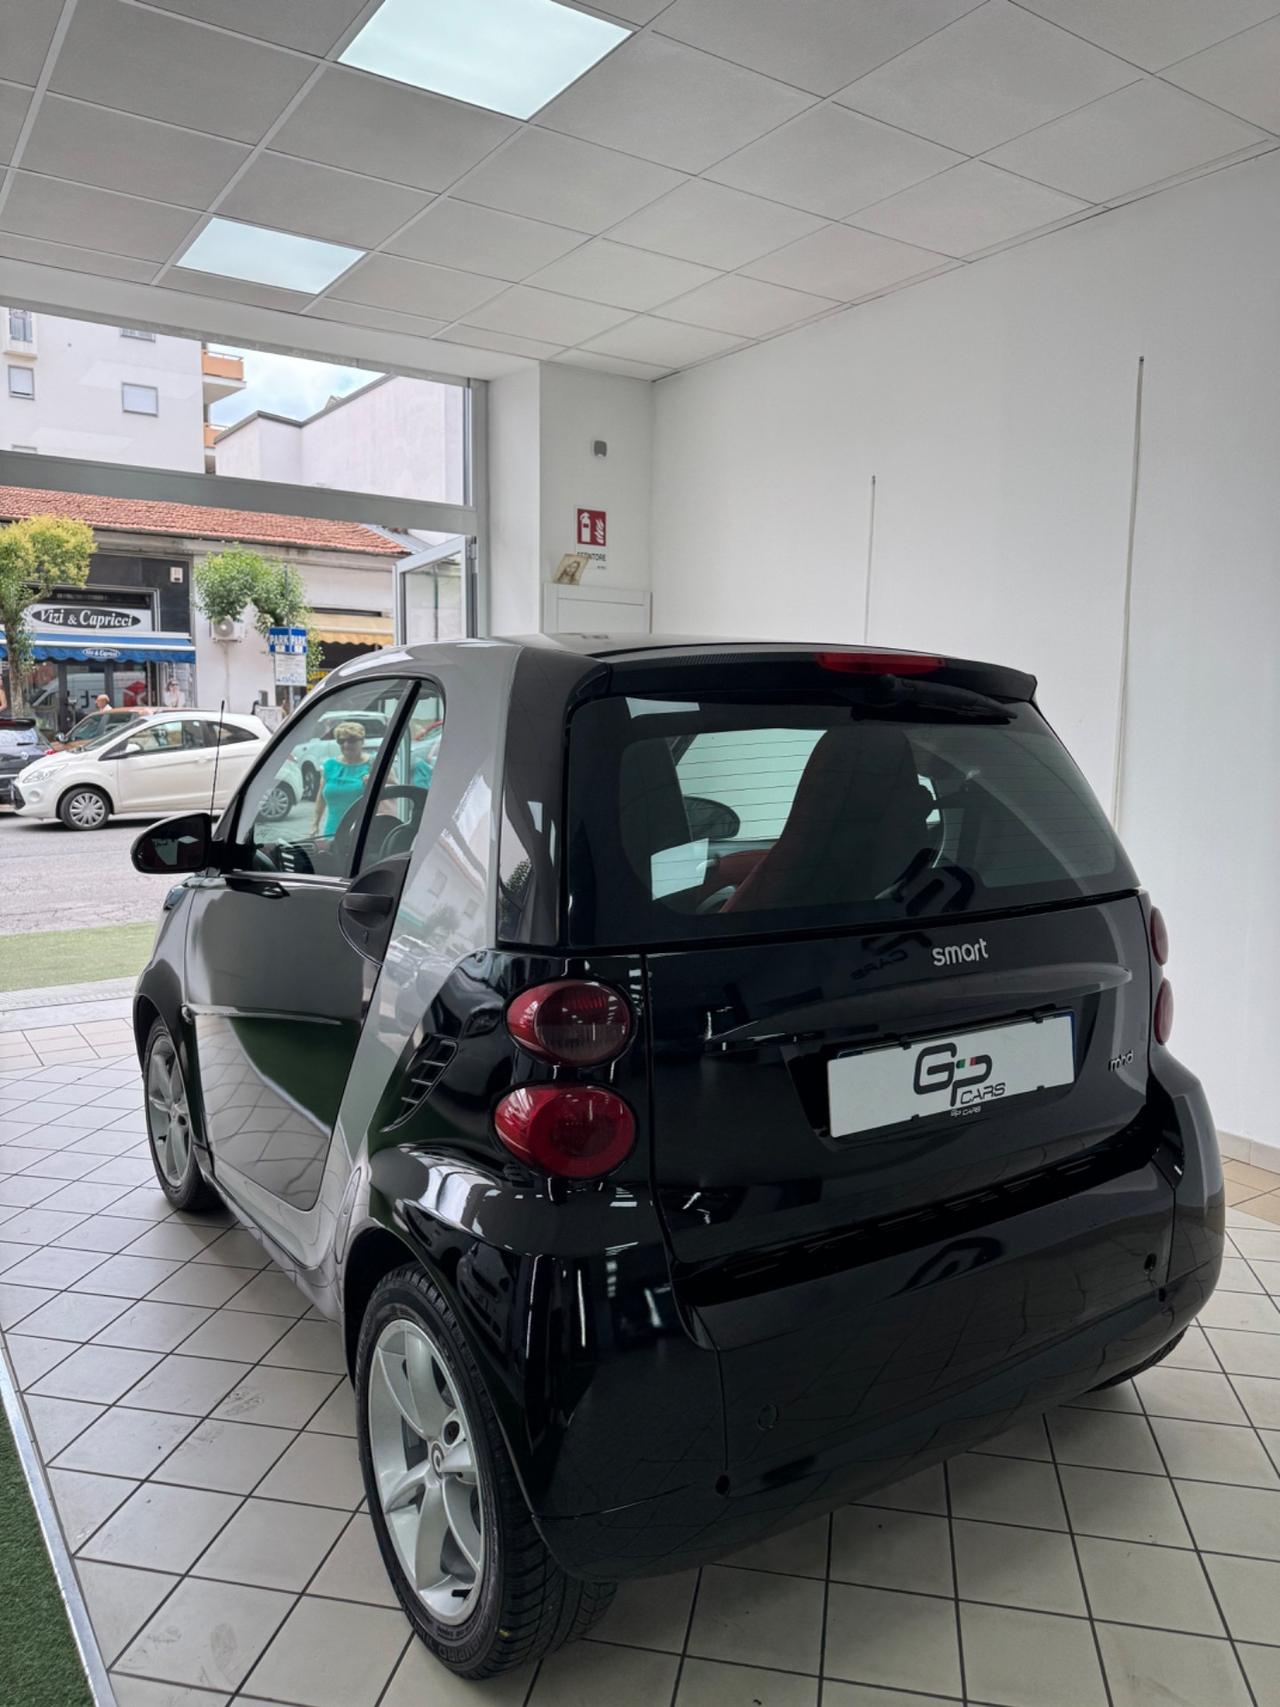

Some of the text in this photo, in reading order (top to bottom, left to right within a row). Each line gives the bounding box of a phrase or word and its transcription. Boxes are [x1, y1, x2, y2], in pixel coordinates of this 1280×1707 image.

[40, 608, 133, 628] Vizi & Capricci
[932, 938, 989, 967] smart
[913, 1042, 993, 1107] GP
[960, 1082, 1006, 1105] CARS
